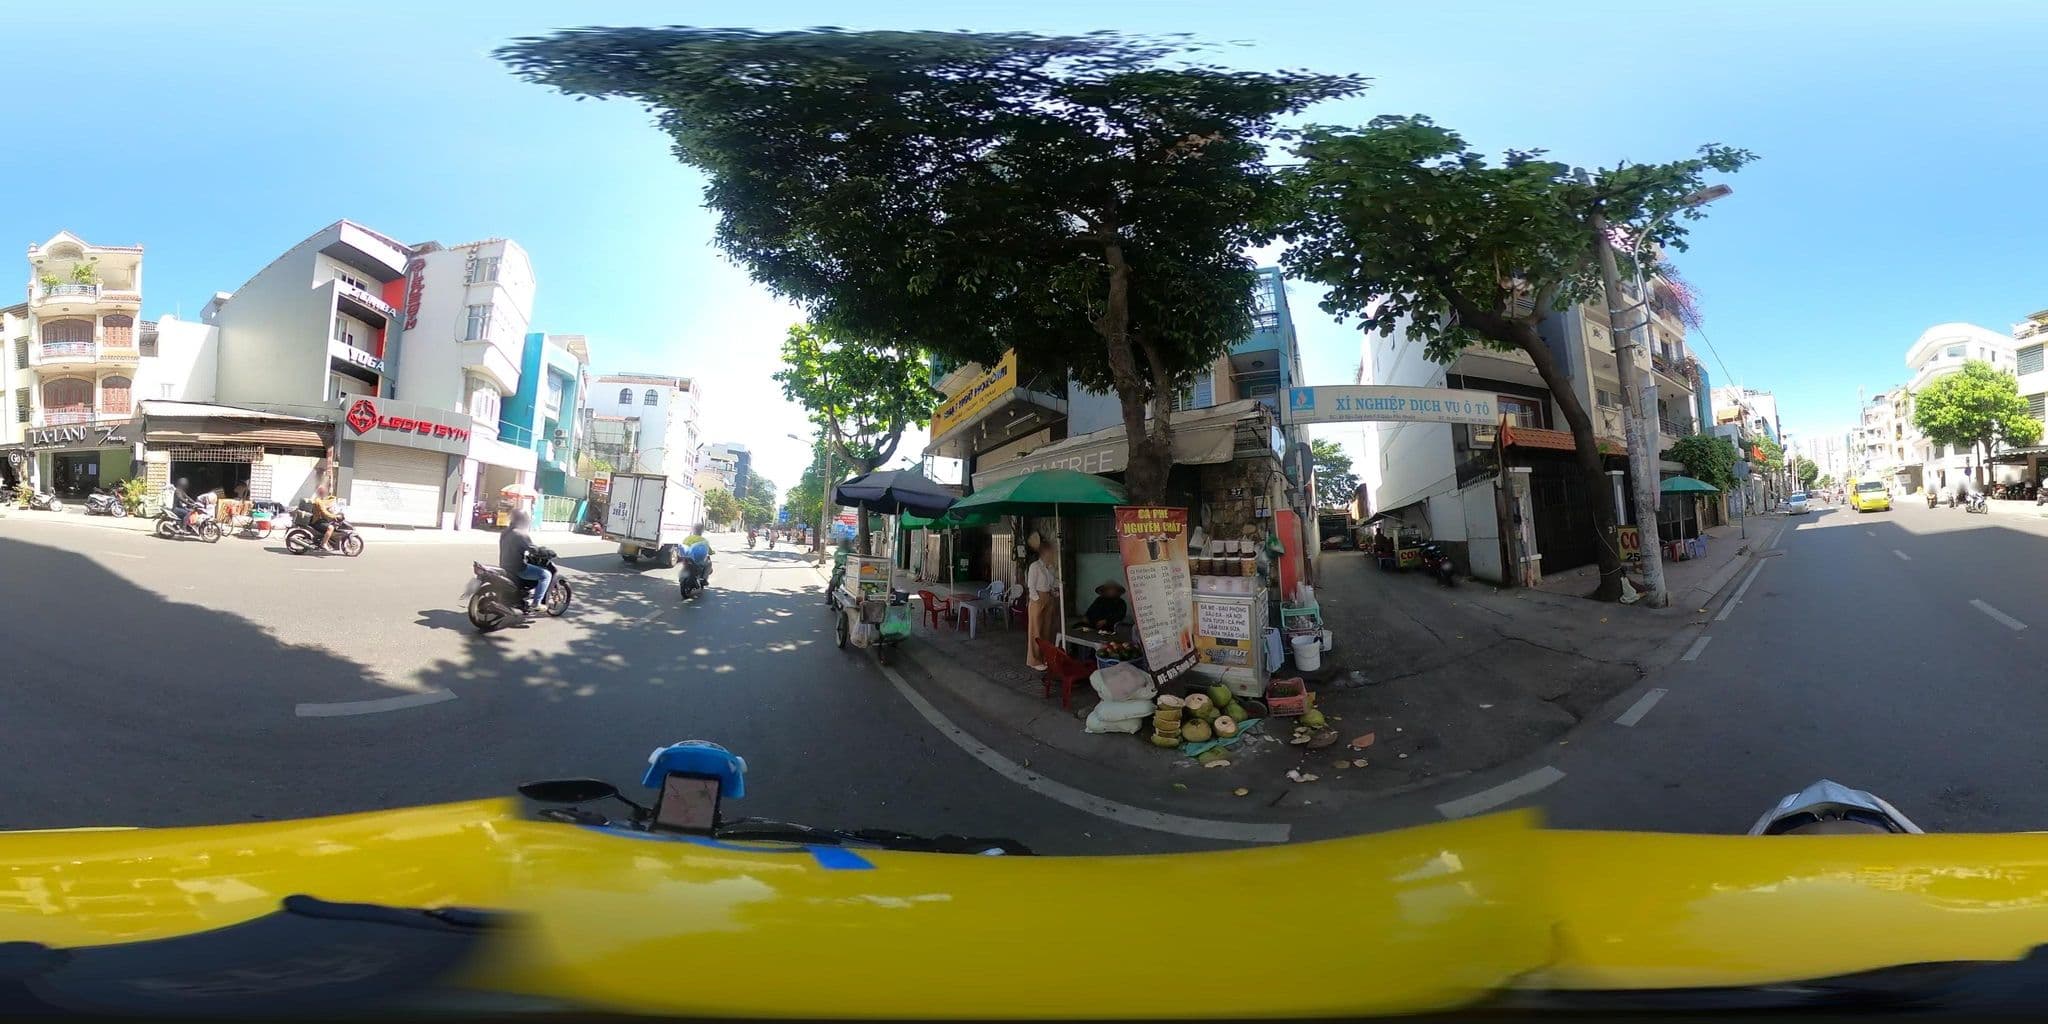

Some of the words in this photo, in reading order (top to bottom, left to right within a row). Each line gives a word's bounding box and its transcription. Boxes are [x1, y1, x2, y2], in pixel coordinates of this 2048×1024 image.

[1336, 395, 1351, 410] XÍ
[1355, 395, 1405, 413] NGHIỆP
[1410, 399, 1440, 414] DỊCH
[1444, 400, 1460, 415] VỤ
[1464, 400, 1471, 414] Ô
[1475, 402, 1489, 416] TÔ
